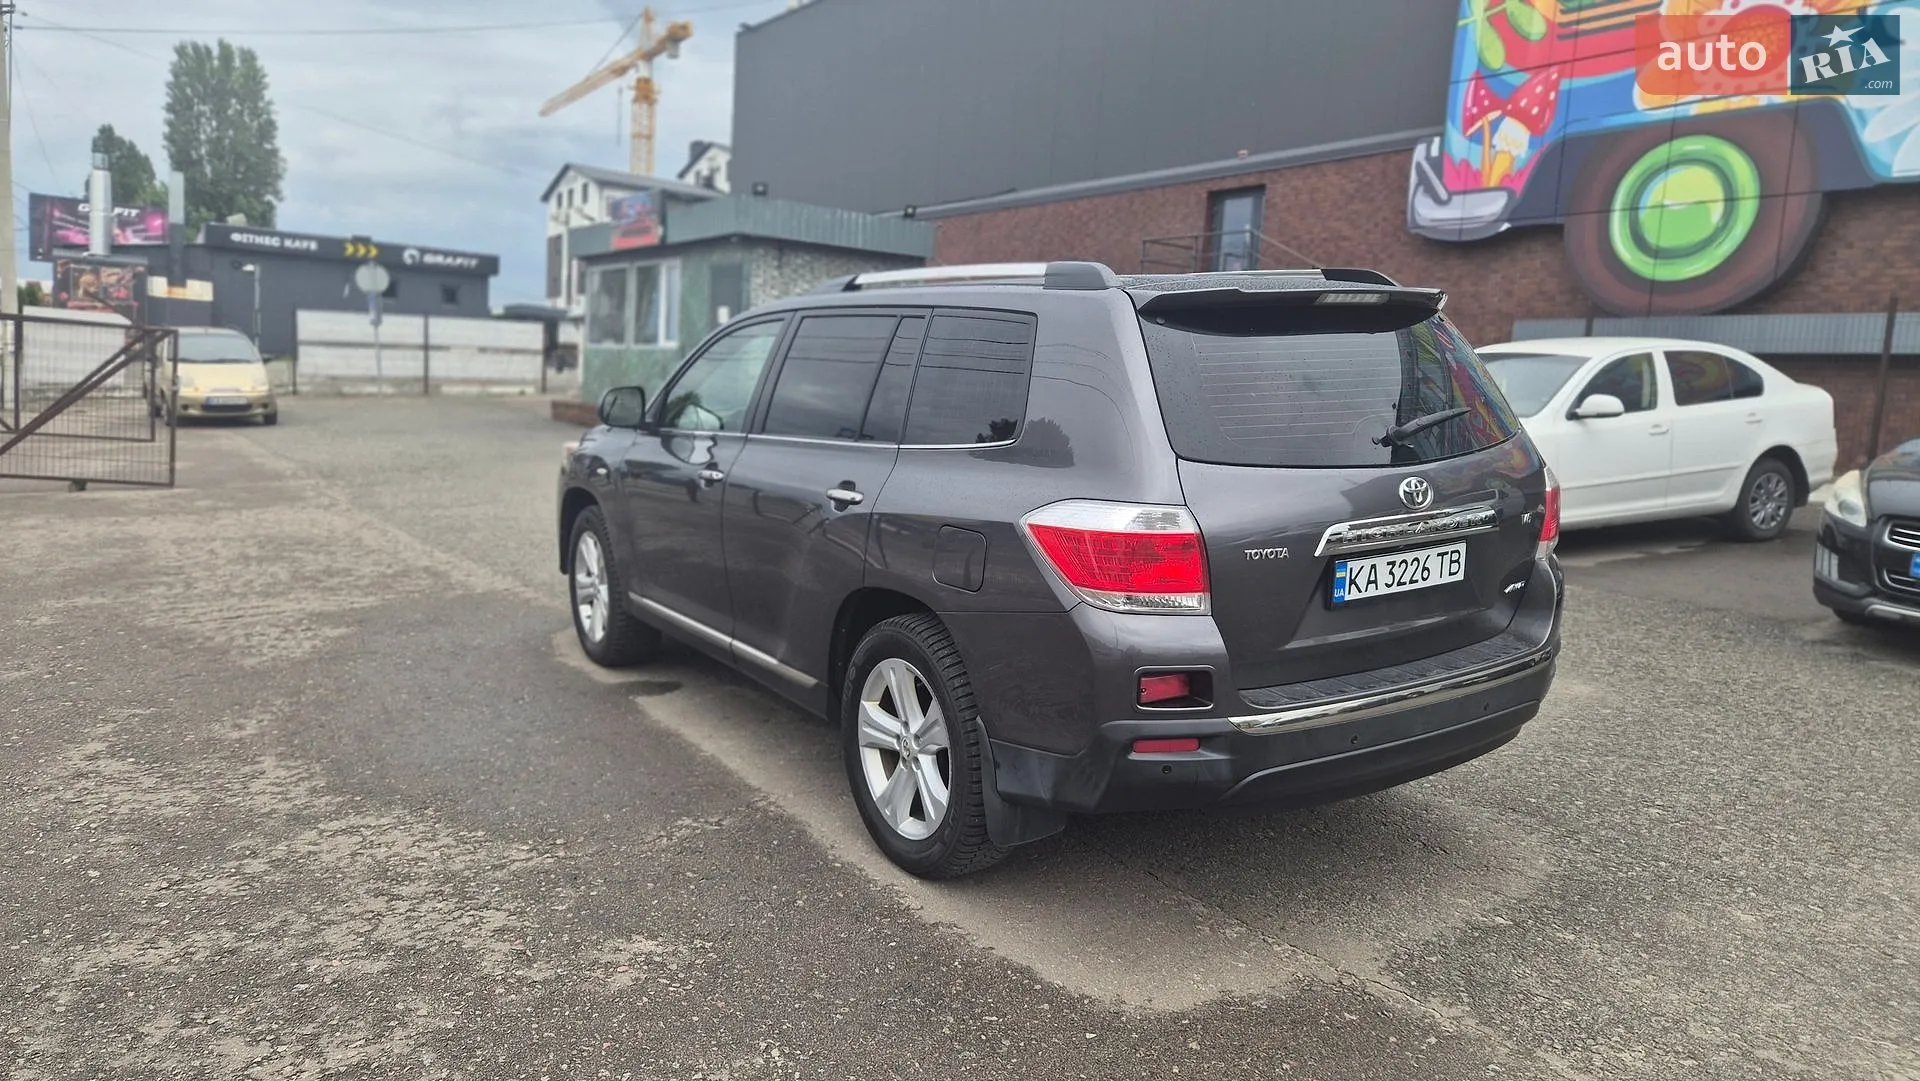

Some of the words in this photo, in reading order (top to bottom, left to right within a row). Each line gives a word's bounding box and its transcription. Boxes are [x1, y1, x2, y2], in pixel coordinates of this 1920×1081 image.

[1244, 547, 1289, 560] TOYOTA
[1348, 562, 1380, 595] KA
[1384, 559, 1431, 589] 3226
[1436, 549, 1462, 579] TB
[1334, 588, 1344, 597] UA
